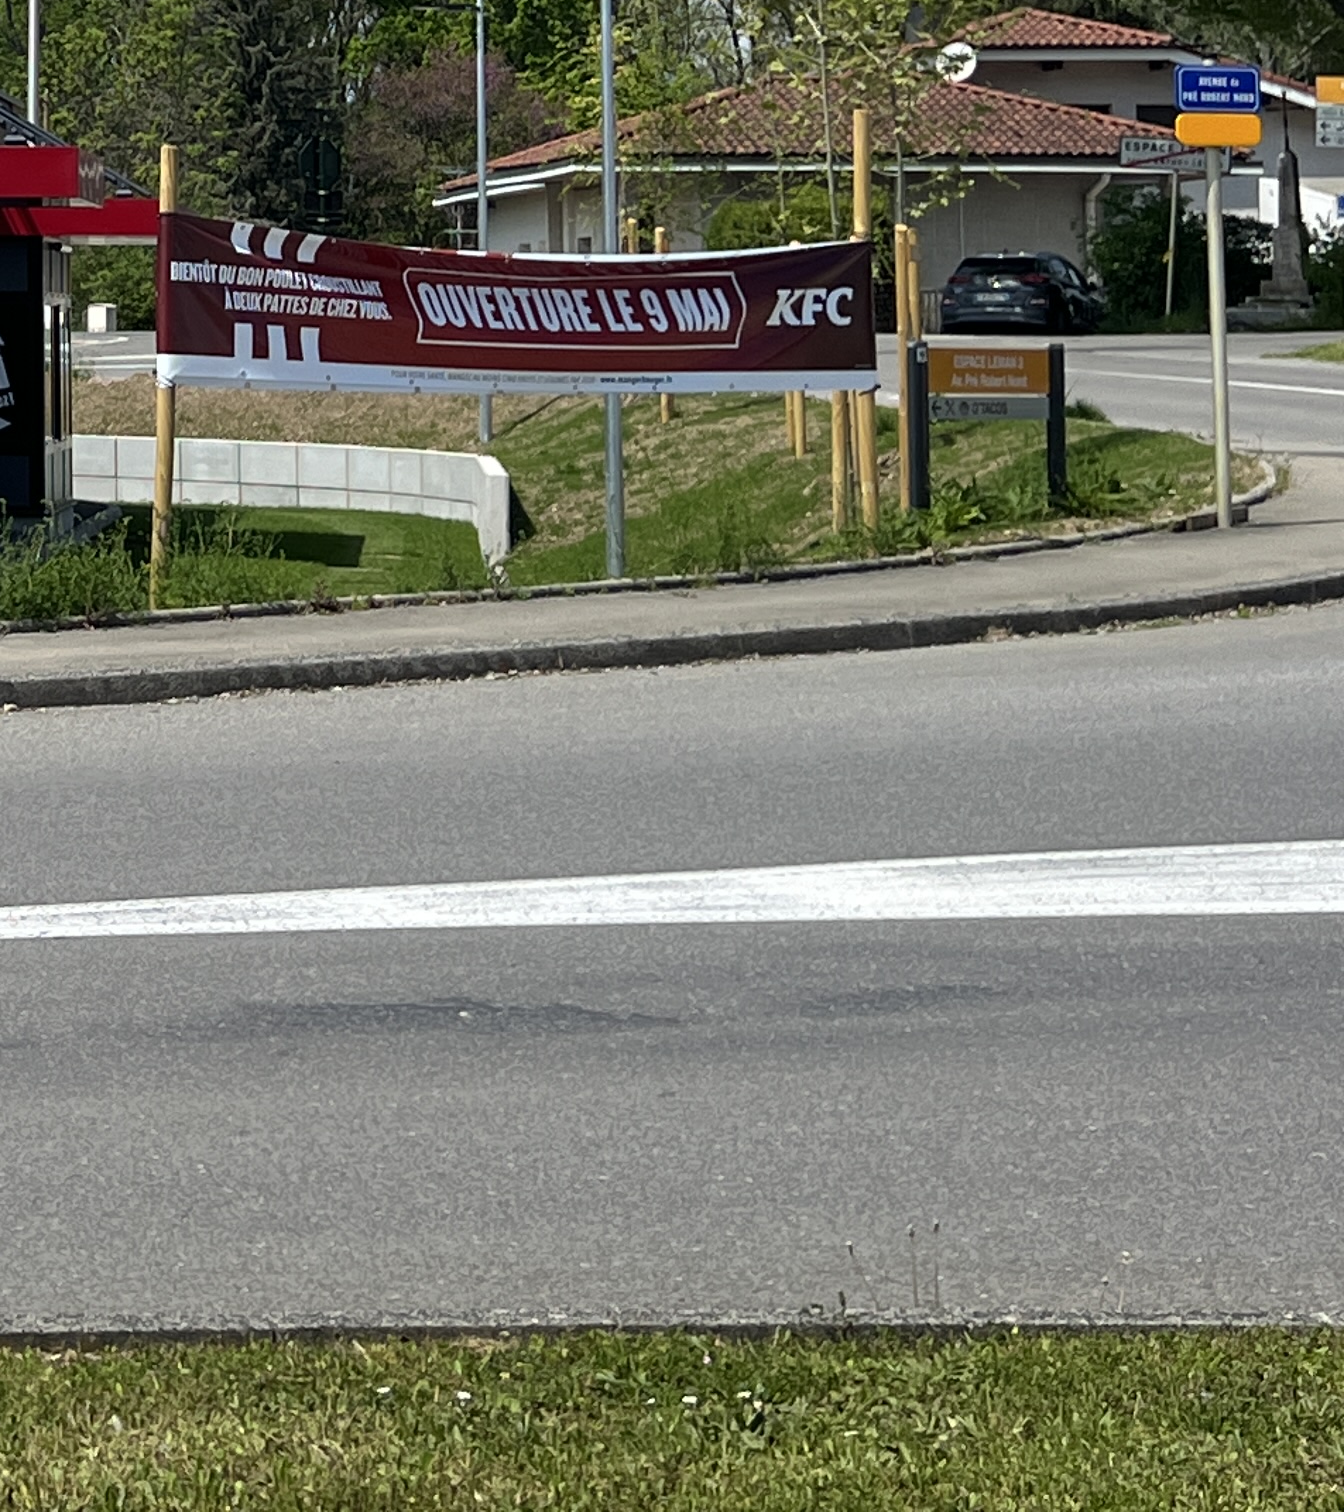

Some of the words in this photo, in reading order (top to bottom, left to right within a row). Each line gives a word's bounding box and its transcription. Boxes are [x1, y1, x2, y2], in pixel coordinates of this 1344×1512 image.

[218, 264, 237, 284] DU
[236, 267, 265, 286] BON
[264, 269, 308, 289] POULET
[232, 291, 263, 312] DEUX
[263, 292, 310, 315] PATTES
[309, 296, 328, 316] DE
[327, 297, 358, 318] CHEZ
[417, 281, 602, 332] OUVERTURE
[598, 287, 645, 332] LE
[640, 287, 668, 333] 9
[665, 287, 731, 332] MAI
[766, 287, 854, 326] KFC
